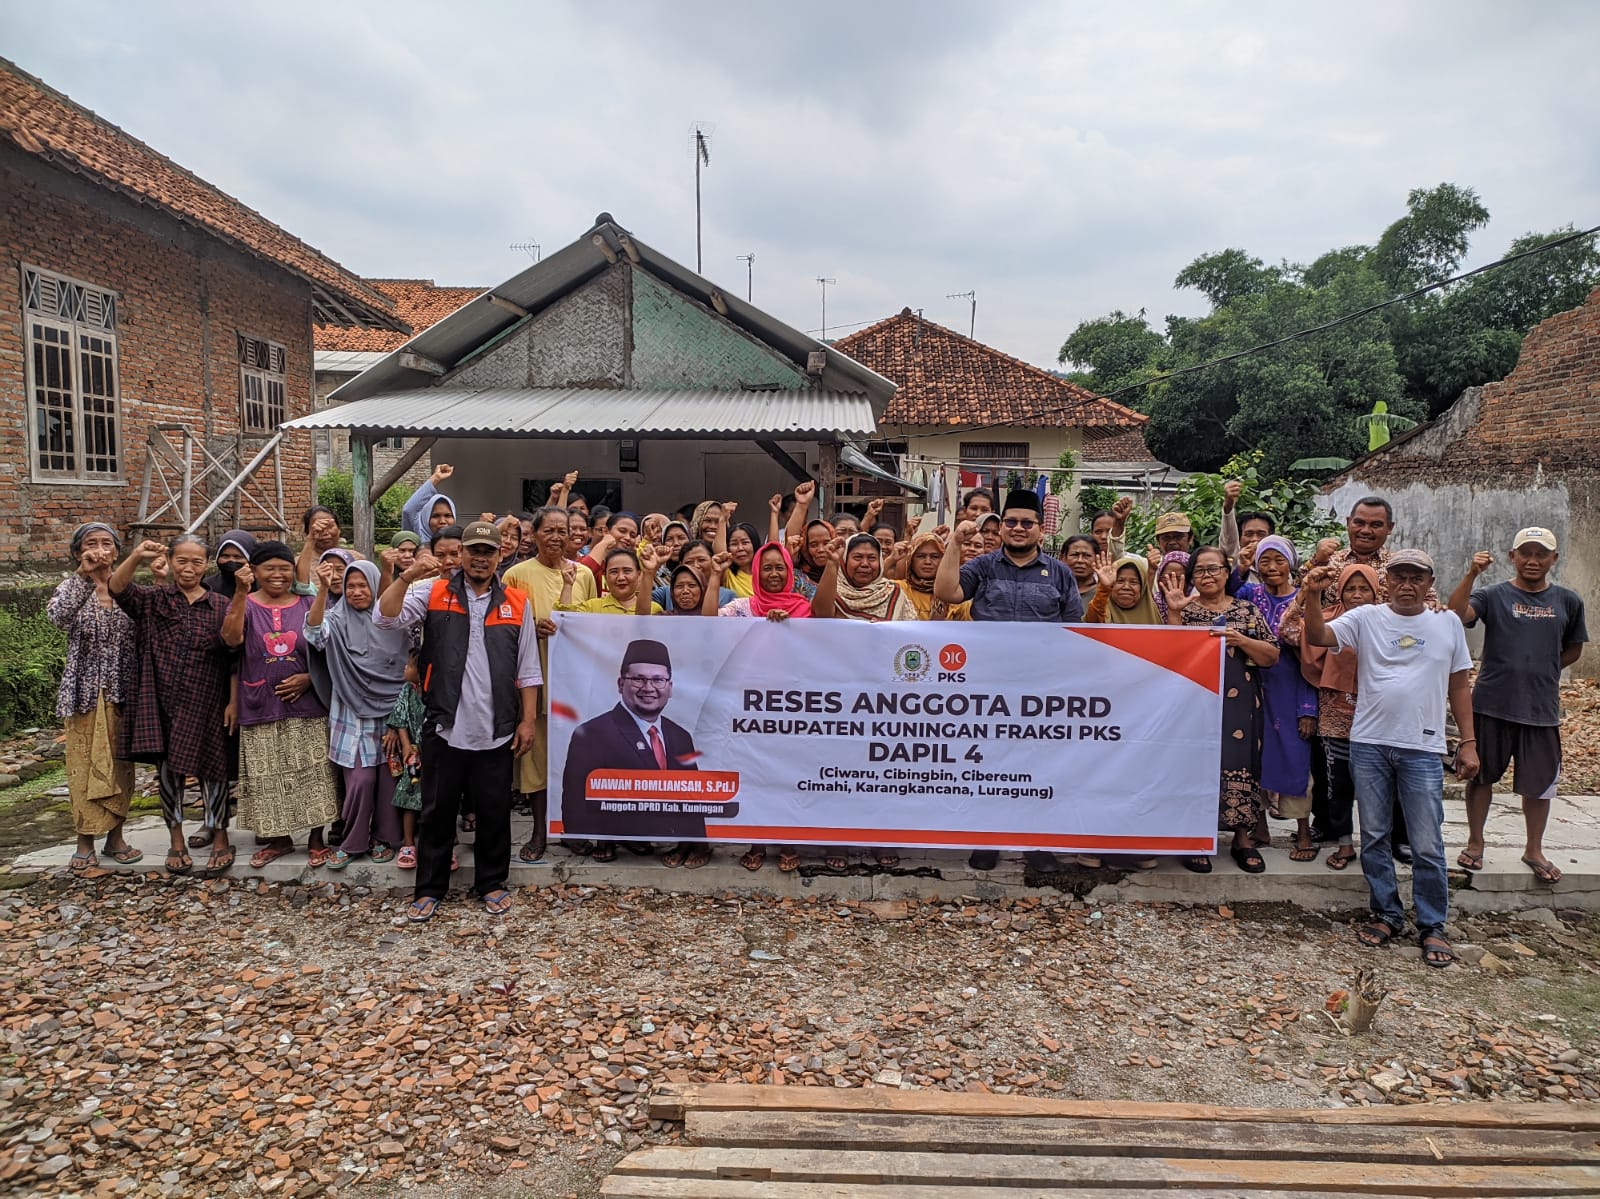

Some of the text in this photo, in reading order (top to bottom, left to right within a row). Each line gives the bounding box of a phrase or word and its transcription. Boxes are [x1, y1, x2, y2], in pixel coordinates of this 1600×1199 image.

[938, 672, 966, 682] PKS
[743, 689, 1112, 718] RESES ANGGOTA DPRD
[732, 718, 1121, 741] KABUPATEN KUNINGAN FRAKSI PKS
[868, 742, 984, 764] DAPIL 4
[819, 766, 1032, 783] (Ciwaru, Cibingbin, Cibereum
[590, 778, 632, 790] WAWAN
[634, 779, 704, 793] ROMLIANSAH,
[797, 780, 1054, 799] Cimahi, Karangkancana, Luragung)
[600, 801, 724, 814] Anggota DPRD Kab. Kuningan
